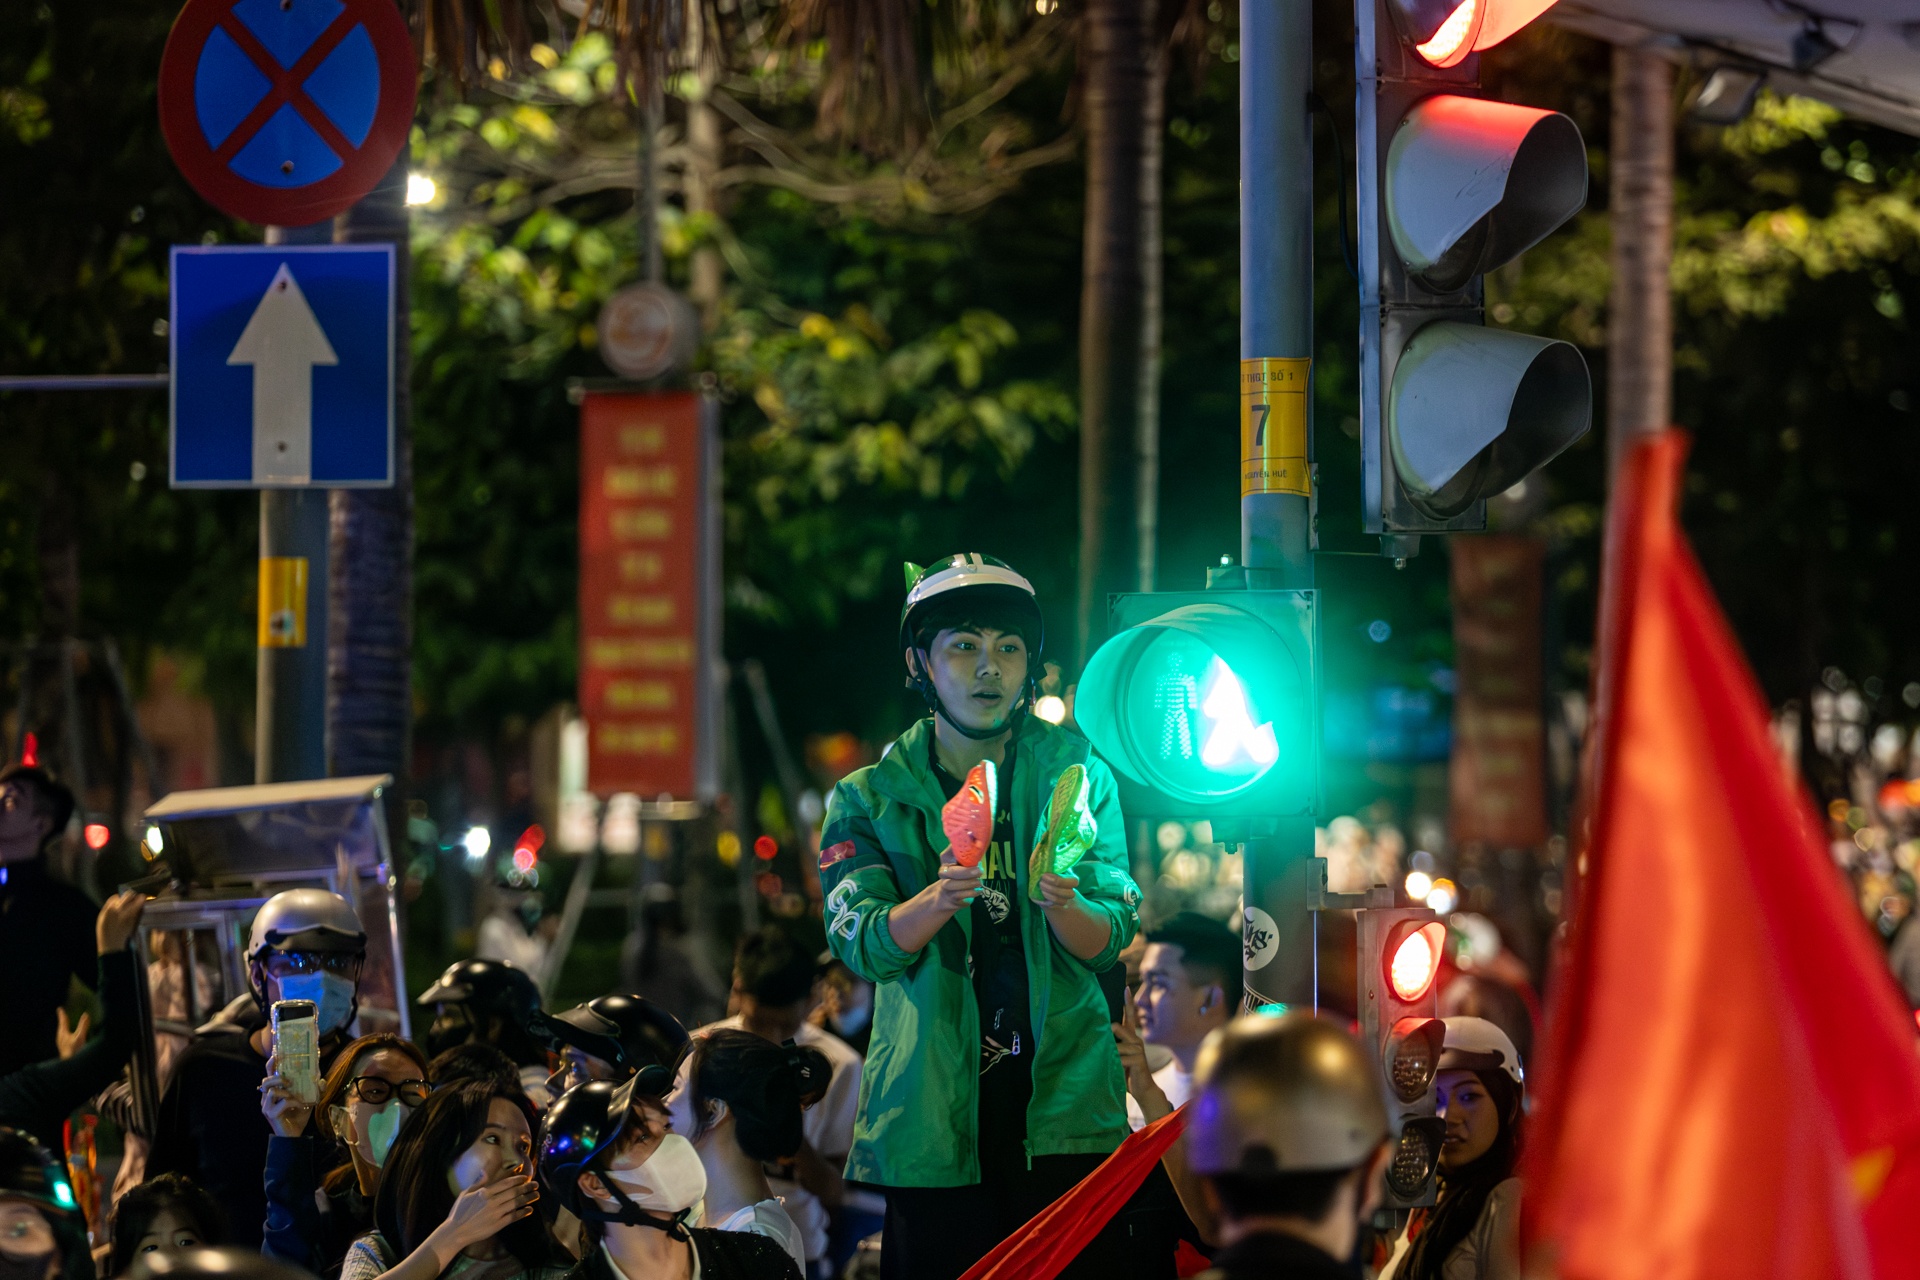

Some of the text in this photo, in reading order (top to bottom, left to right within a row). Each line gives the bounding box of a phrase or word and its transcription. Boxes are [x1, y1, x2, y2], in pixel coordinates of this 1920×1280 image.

[1271, 369, 1285, 381] SỐ
[1288, 372, 1293, 381] 1
[1252, 405, 1271, 446] 7
